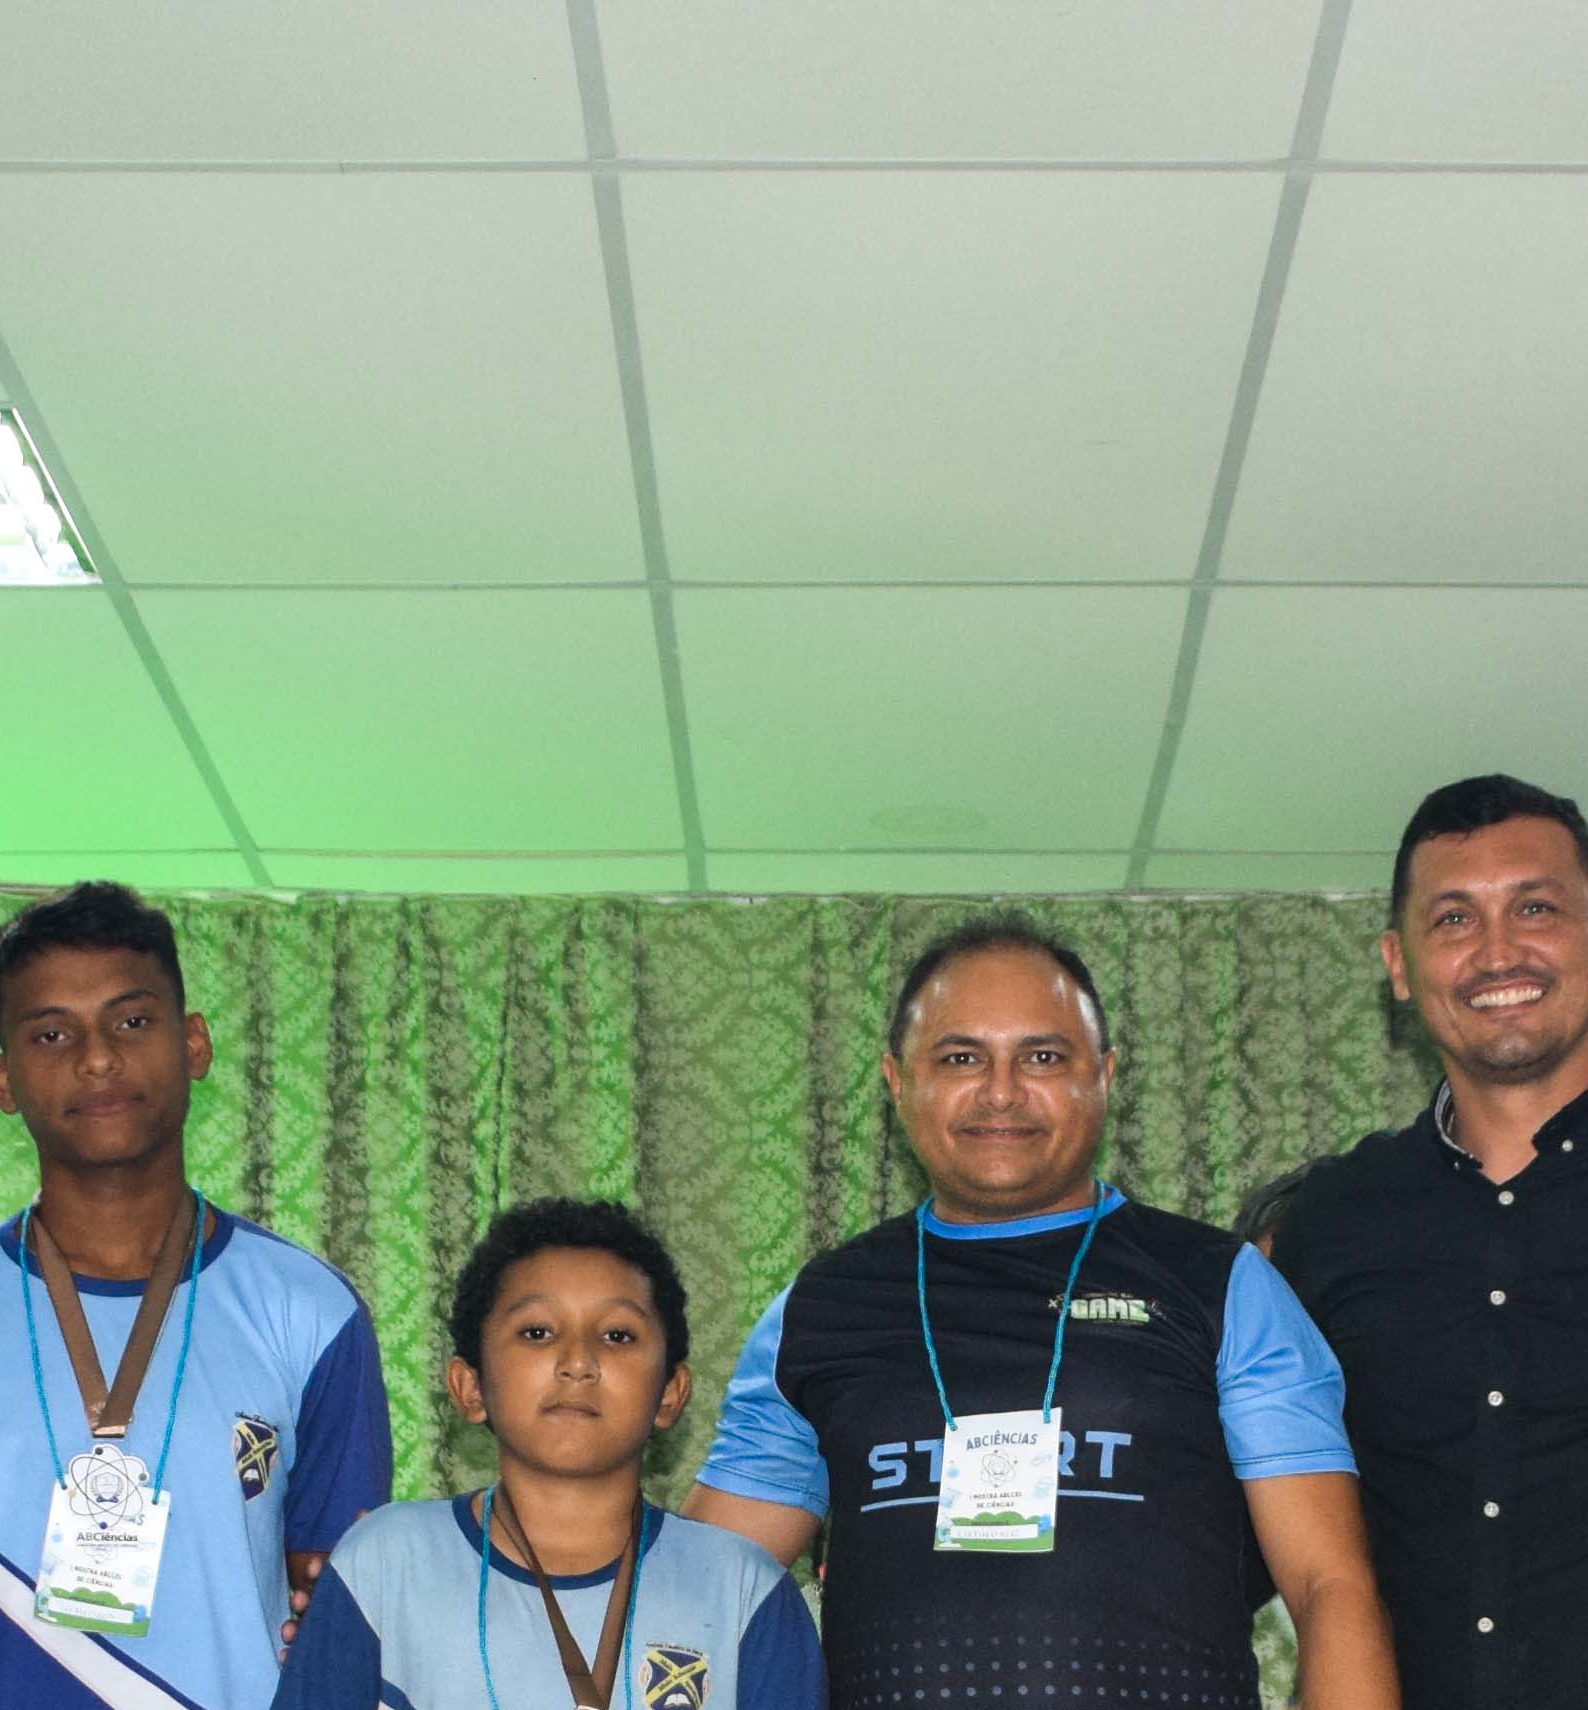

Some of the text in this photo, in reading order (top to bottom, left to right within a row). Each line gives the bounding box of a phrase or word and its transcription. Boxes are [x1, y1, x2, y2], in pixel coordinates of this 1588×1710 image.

[1070, 1297, 1150, 1322] GAME
[966, 1429, 1038, 1451] ABCIÊNCIAS
[868, 1430, 1132, 1490] STRT
